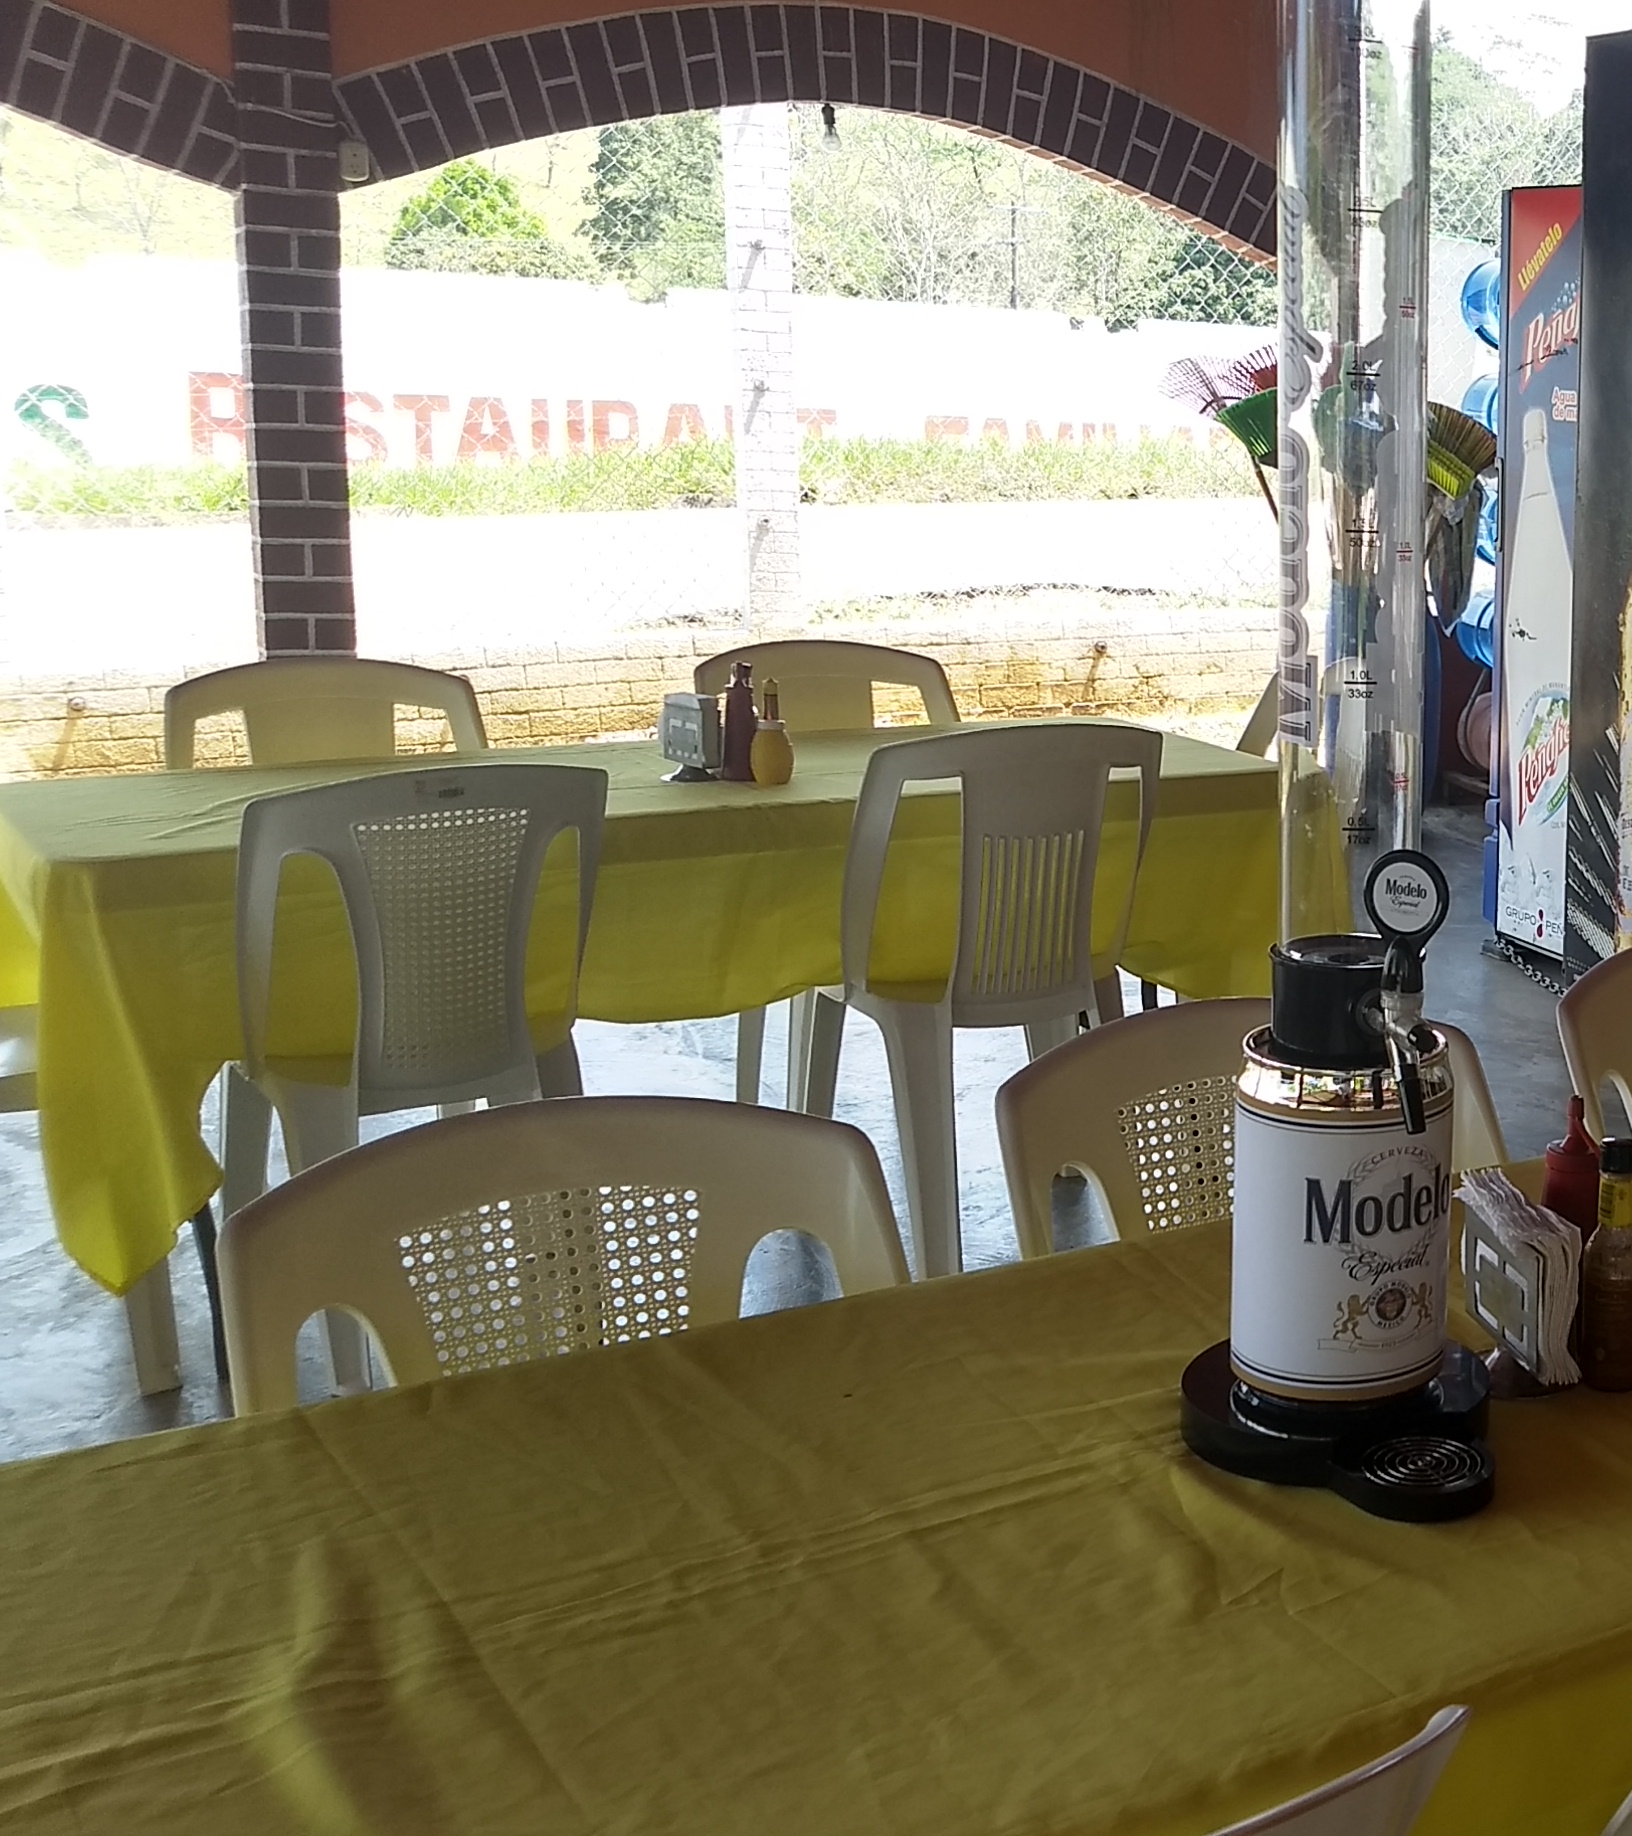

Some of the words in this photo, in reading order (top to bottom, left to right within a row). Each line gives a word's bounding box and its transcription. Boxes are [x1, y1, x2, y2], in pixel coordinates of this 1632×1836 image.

[1517, 221, 1564, 293] Llévatelo
[1351, 360, 1376, 372] 2.0L
[1350, 380, 1377, 392] 67oz
[1553, 387, 1577, 405] Agua
[1554, 404, 1565, 419] de
[1350, 670, 1373, 681] 1.0L
[1347, 688, 1374, 700] 33oz
[1347, 816, 1371, 827] 0.5L
[1346, 835, 1371, 845] 17oz
[1384, 877, 1428, 900] Modelo
[1505, 906, 1537, 926] GRUPO
[1370, 1145, 1424, 1165] CERVEZA
[1303, 1162, 1450, 1244] Modelo
[1341, 1243, 1429, 1286] Especial
